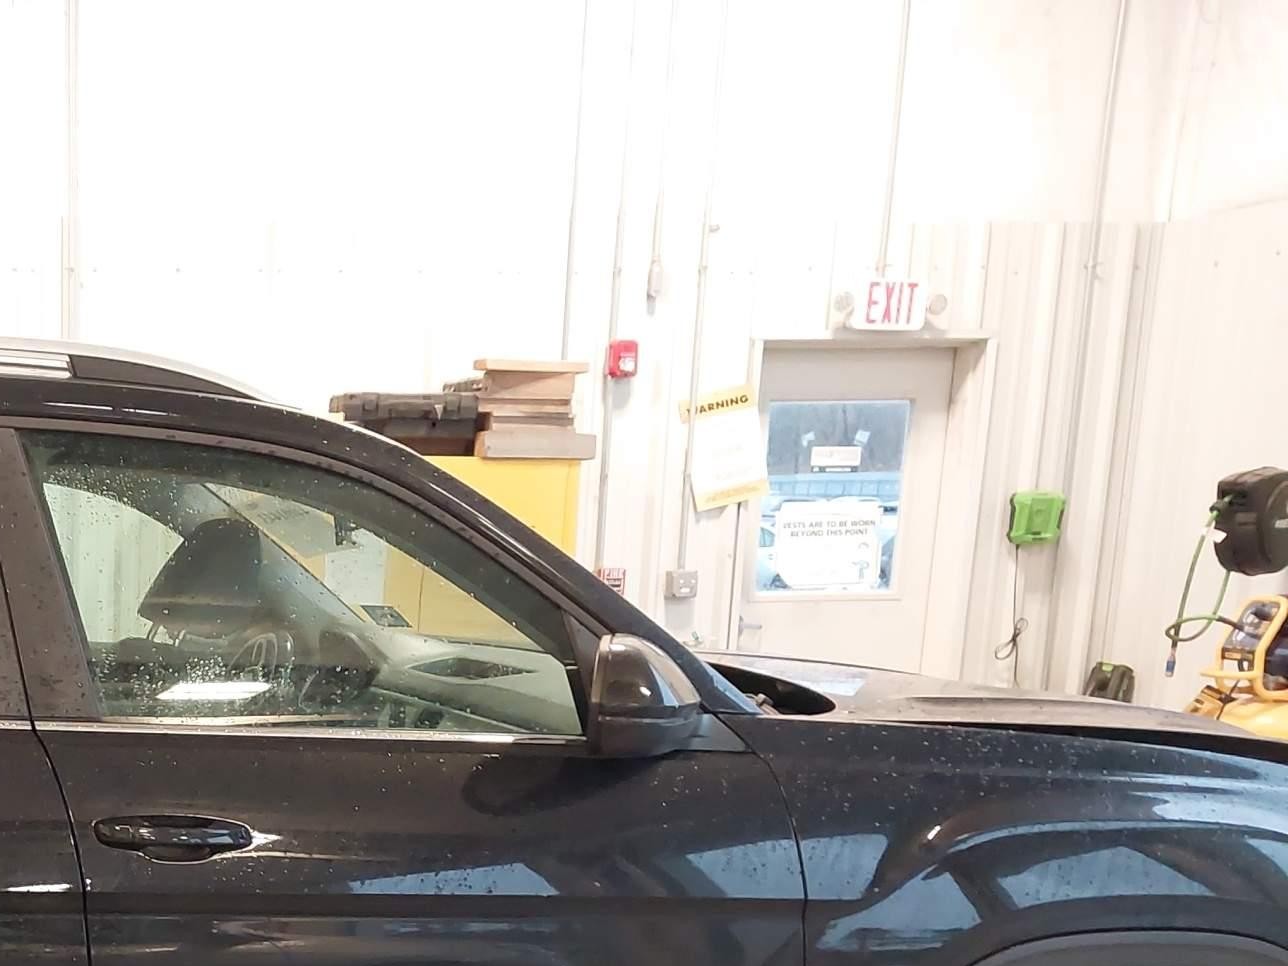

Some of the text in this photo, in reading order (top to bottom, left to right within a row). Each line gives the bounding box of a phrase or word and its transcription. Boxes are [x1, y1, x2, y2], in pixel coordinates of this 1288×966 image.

[865, 281, 919, 325] EXIT
[783, 521, 806, 529] VESTS
[827, 520, 837, 528] TO
[839, 520, 848, 528] BE
[851, 519, 876, 527] WORN
[790, 528, 868, 537] BEYOND THIS POINT
